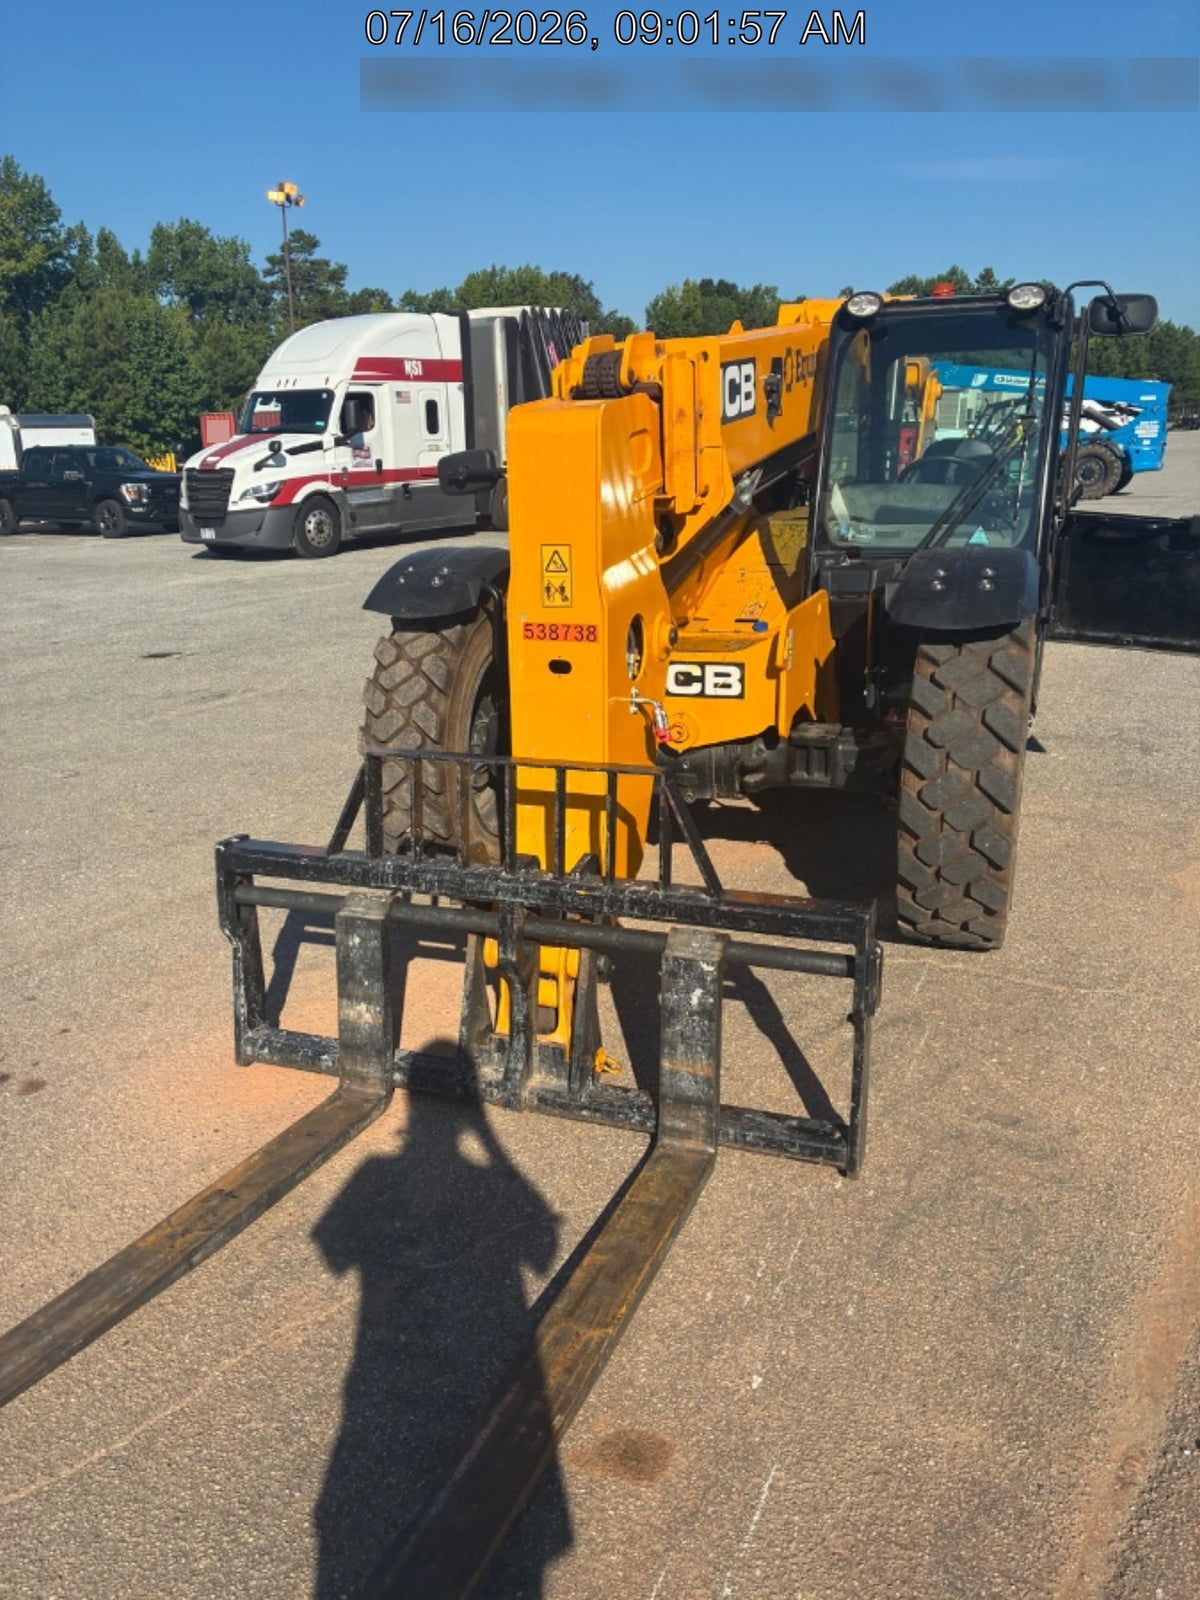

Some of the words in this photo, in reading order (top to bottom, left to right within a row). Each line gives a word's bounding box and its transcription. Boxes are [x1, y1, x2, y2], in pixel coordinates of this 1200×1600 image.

[722, 362, 755, 417] CB
[523, 623, 597, 642] 538738
[666, 664, 742, 696] CB
